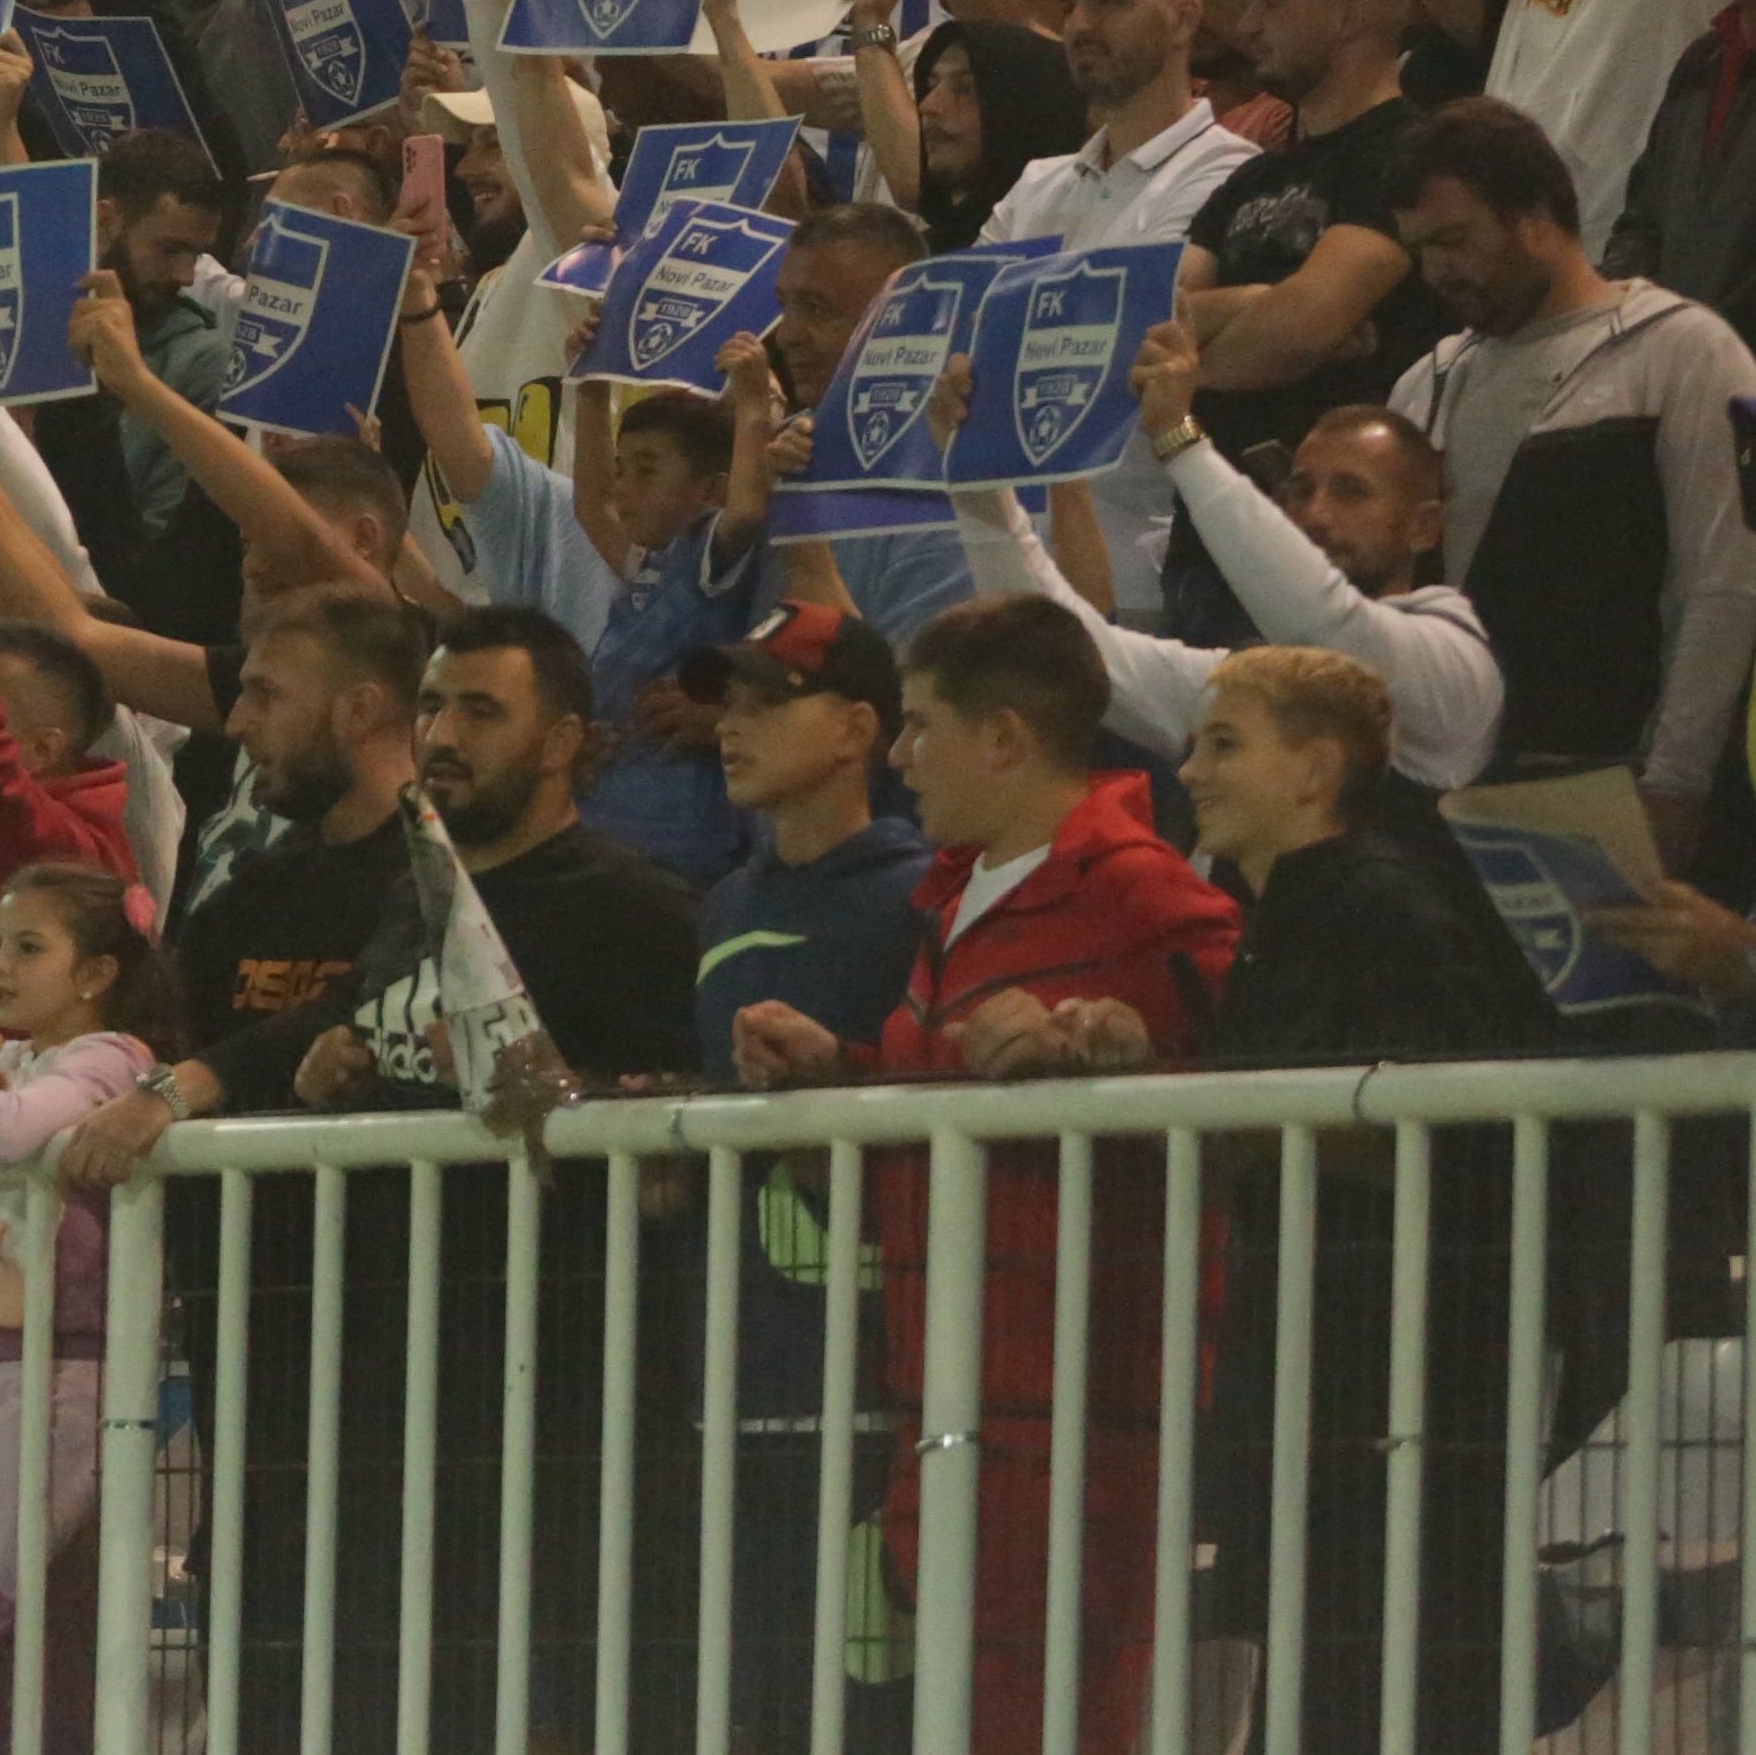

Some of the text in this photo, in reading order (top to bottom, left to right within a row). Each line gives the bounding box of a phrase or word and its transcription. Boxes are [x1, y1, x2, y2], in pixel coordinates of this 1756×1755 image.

[314, 0, 345, 26] Pazar
[80, 80, 121, 98] Pazar
[673, 158, 698, 180] FK
[682, 233, 711, 255] FK
[657, 266, 735, 294] Novi Pazar
[247, 286, 304, 315] Pazar
[1036, 292, 1064, 318] FK
[883, 303, 903, 325] FK
[895, 348, 937, 365] Pazar
[1026, 336, 1108, 360] Novi Pazar
